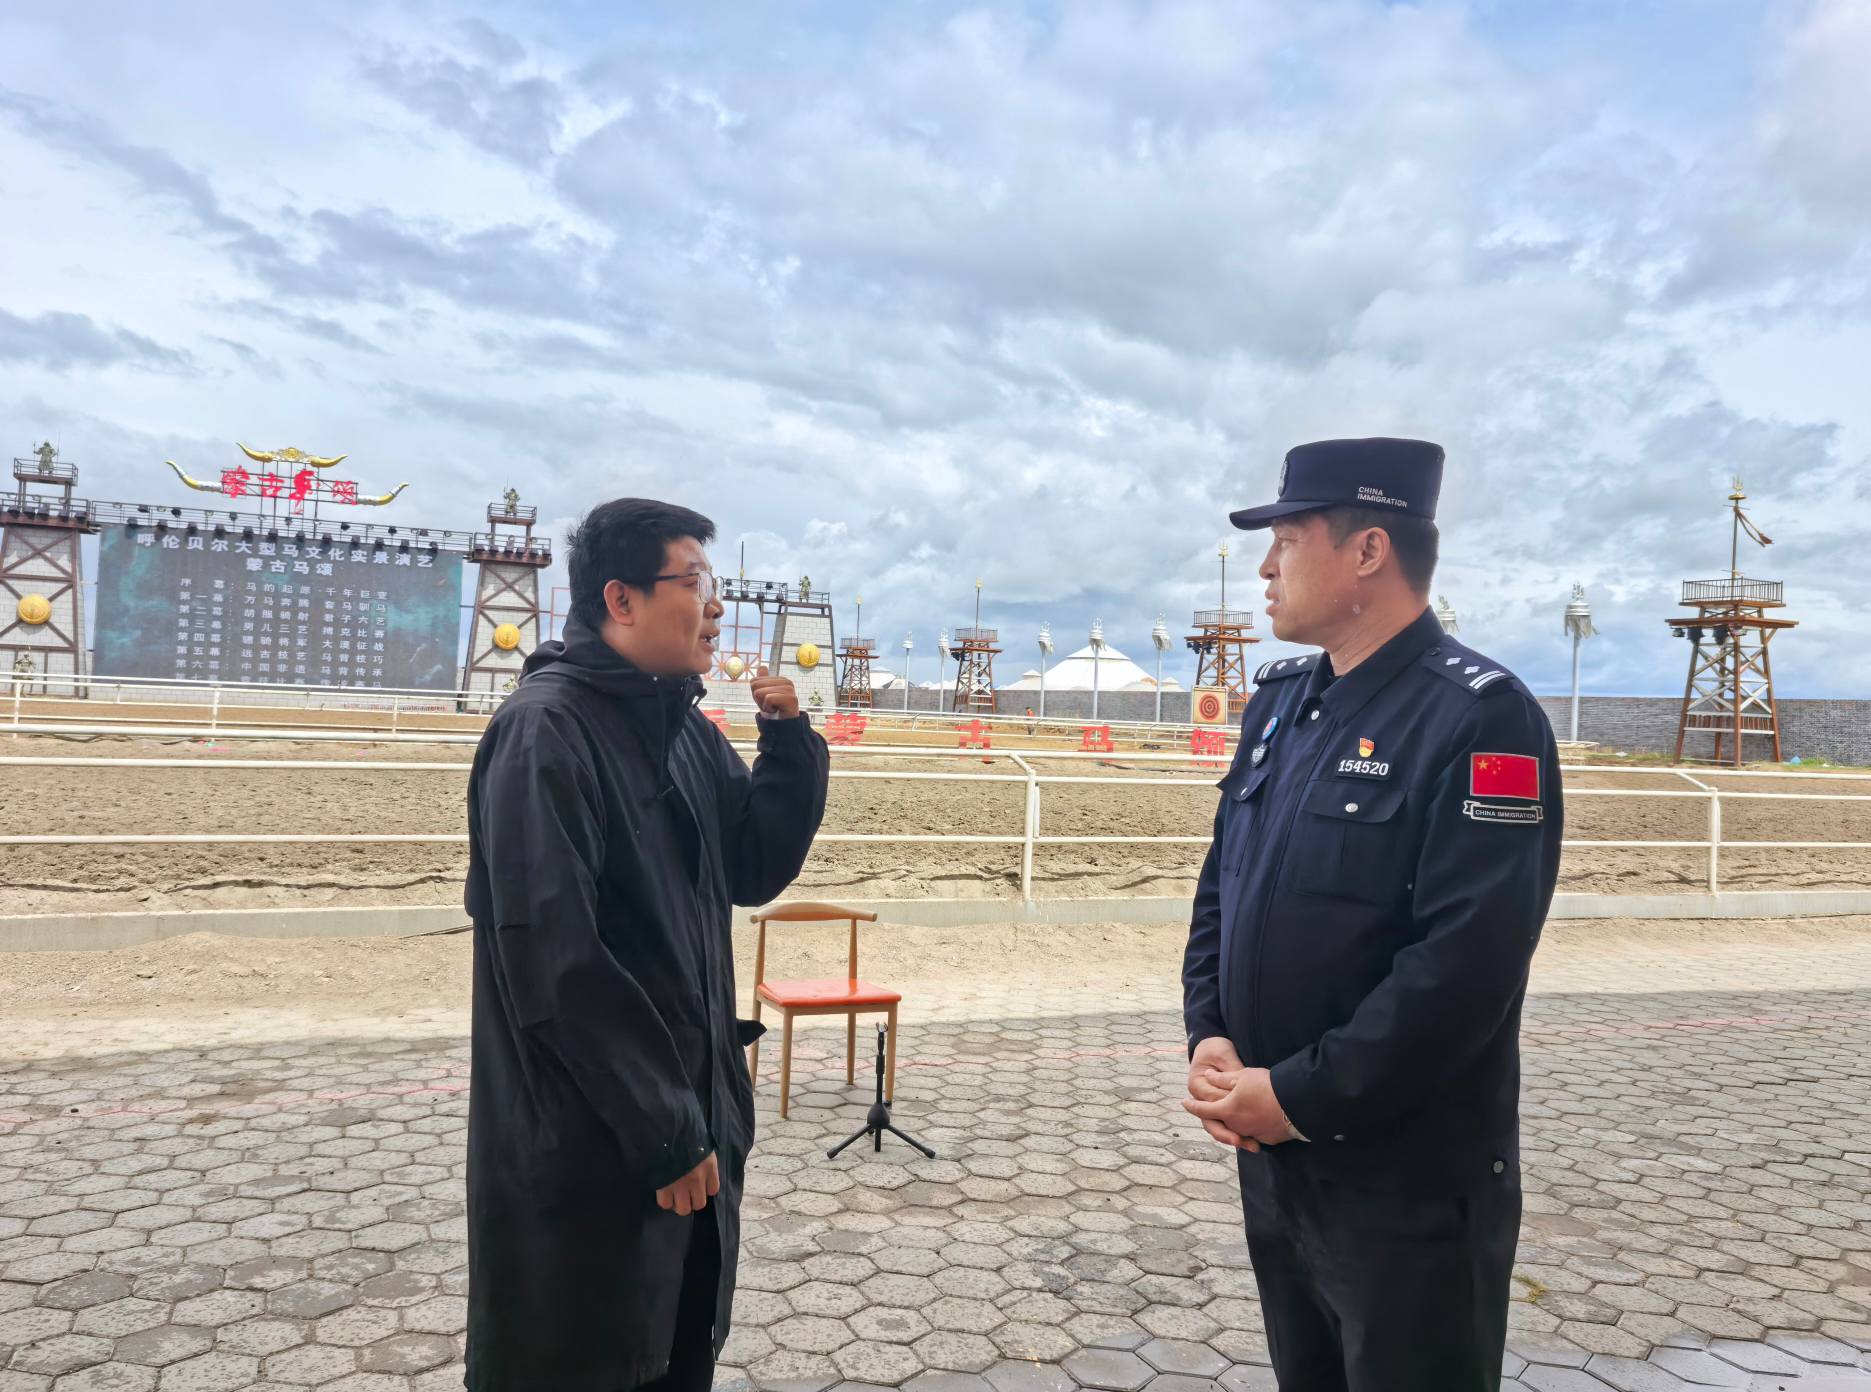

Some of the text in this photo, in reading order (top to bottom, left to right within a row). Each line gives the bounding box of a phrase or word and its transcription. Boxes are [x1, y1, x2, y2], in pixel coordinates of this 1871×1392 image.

[1358, 486, 1384, 496] CHINA
[1357, 493, 1408, 508] IMMIGRATION
[137, 533, 433, 568] 呼伦贝尔大型马文化实景演艺
[245, 559, 334, 576] 蒙古马颂
[1338, 759, 1390, 776] 154520
[1475, 809, 1536, 820] CHINA IMMIGRATION
